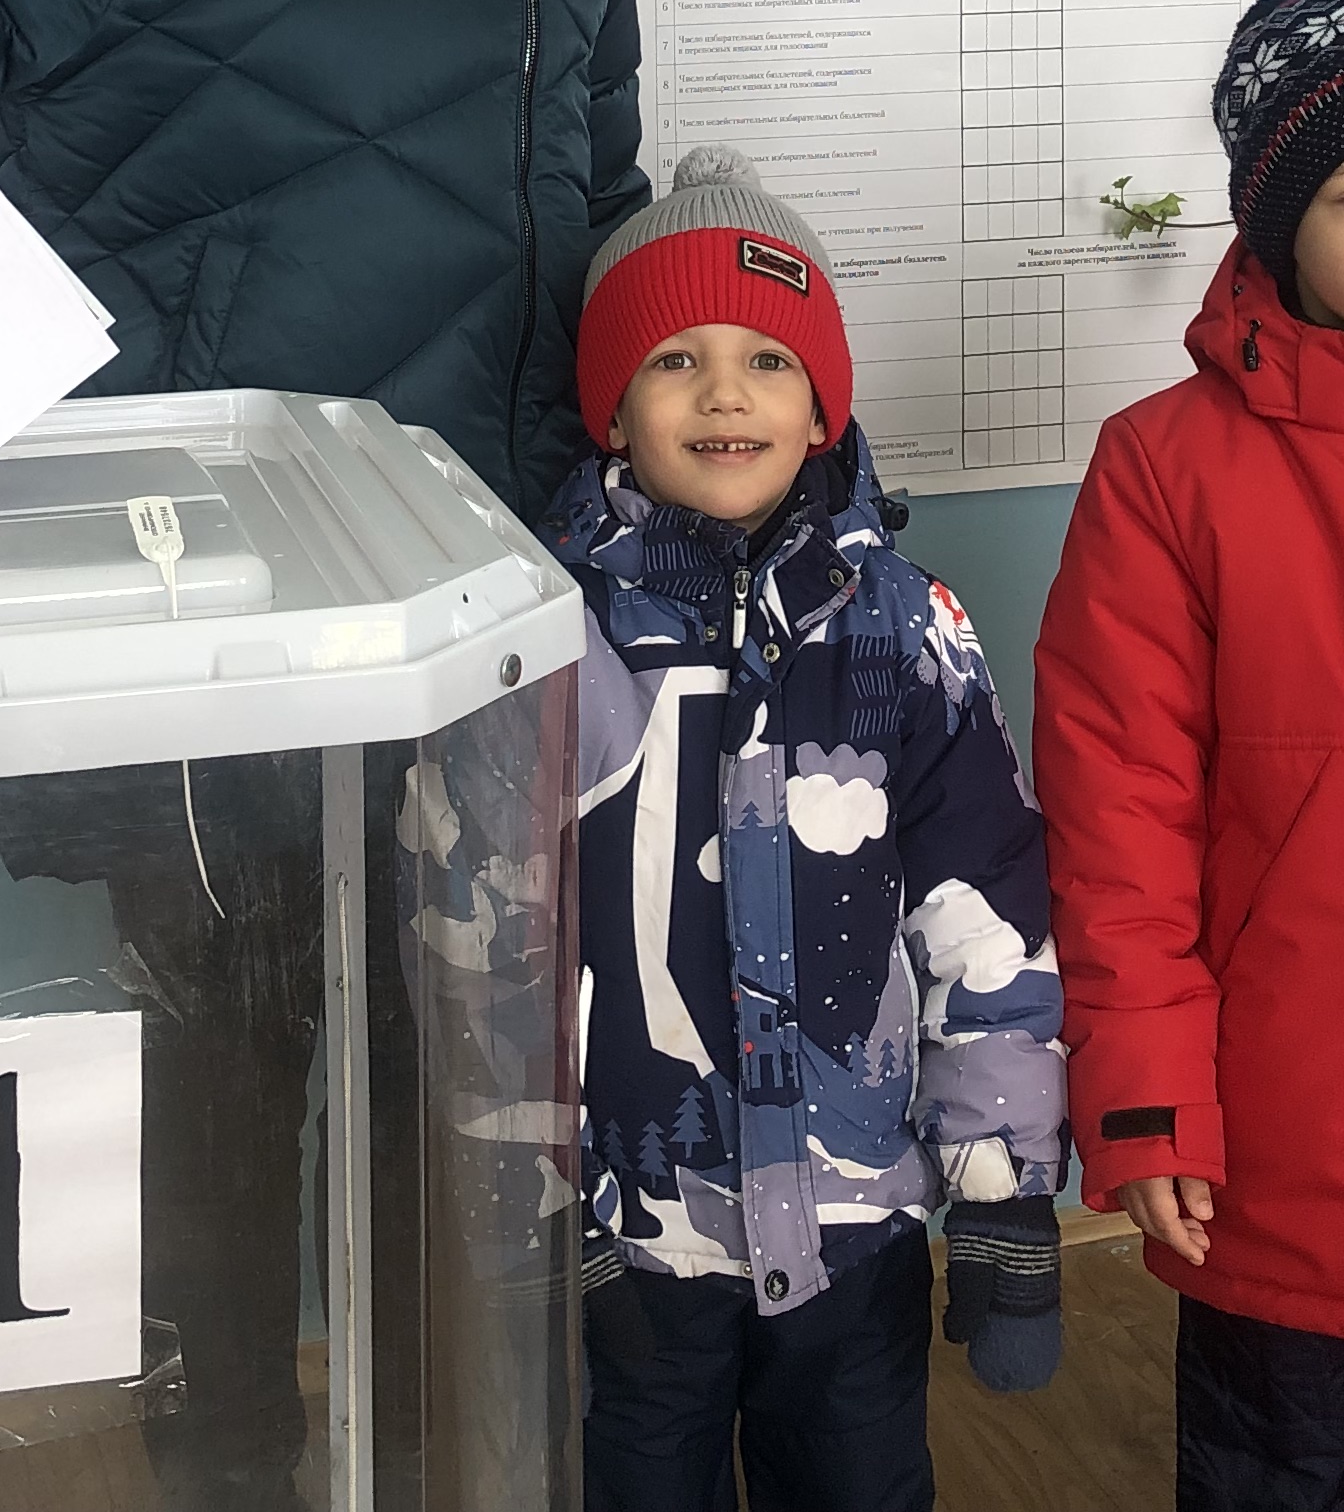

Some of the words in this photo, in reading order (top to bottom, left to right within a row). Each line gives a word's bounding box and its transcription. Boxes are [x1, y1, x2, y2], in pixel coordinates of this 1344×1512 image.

[663, 2, 668, 11] 6
[663, 41, 668, 50] 7
[663, 81, 669, 89] 8
[664, 120, 669, 129] 9
[663, 159, 672, 168] 10
